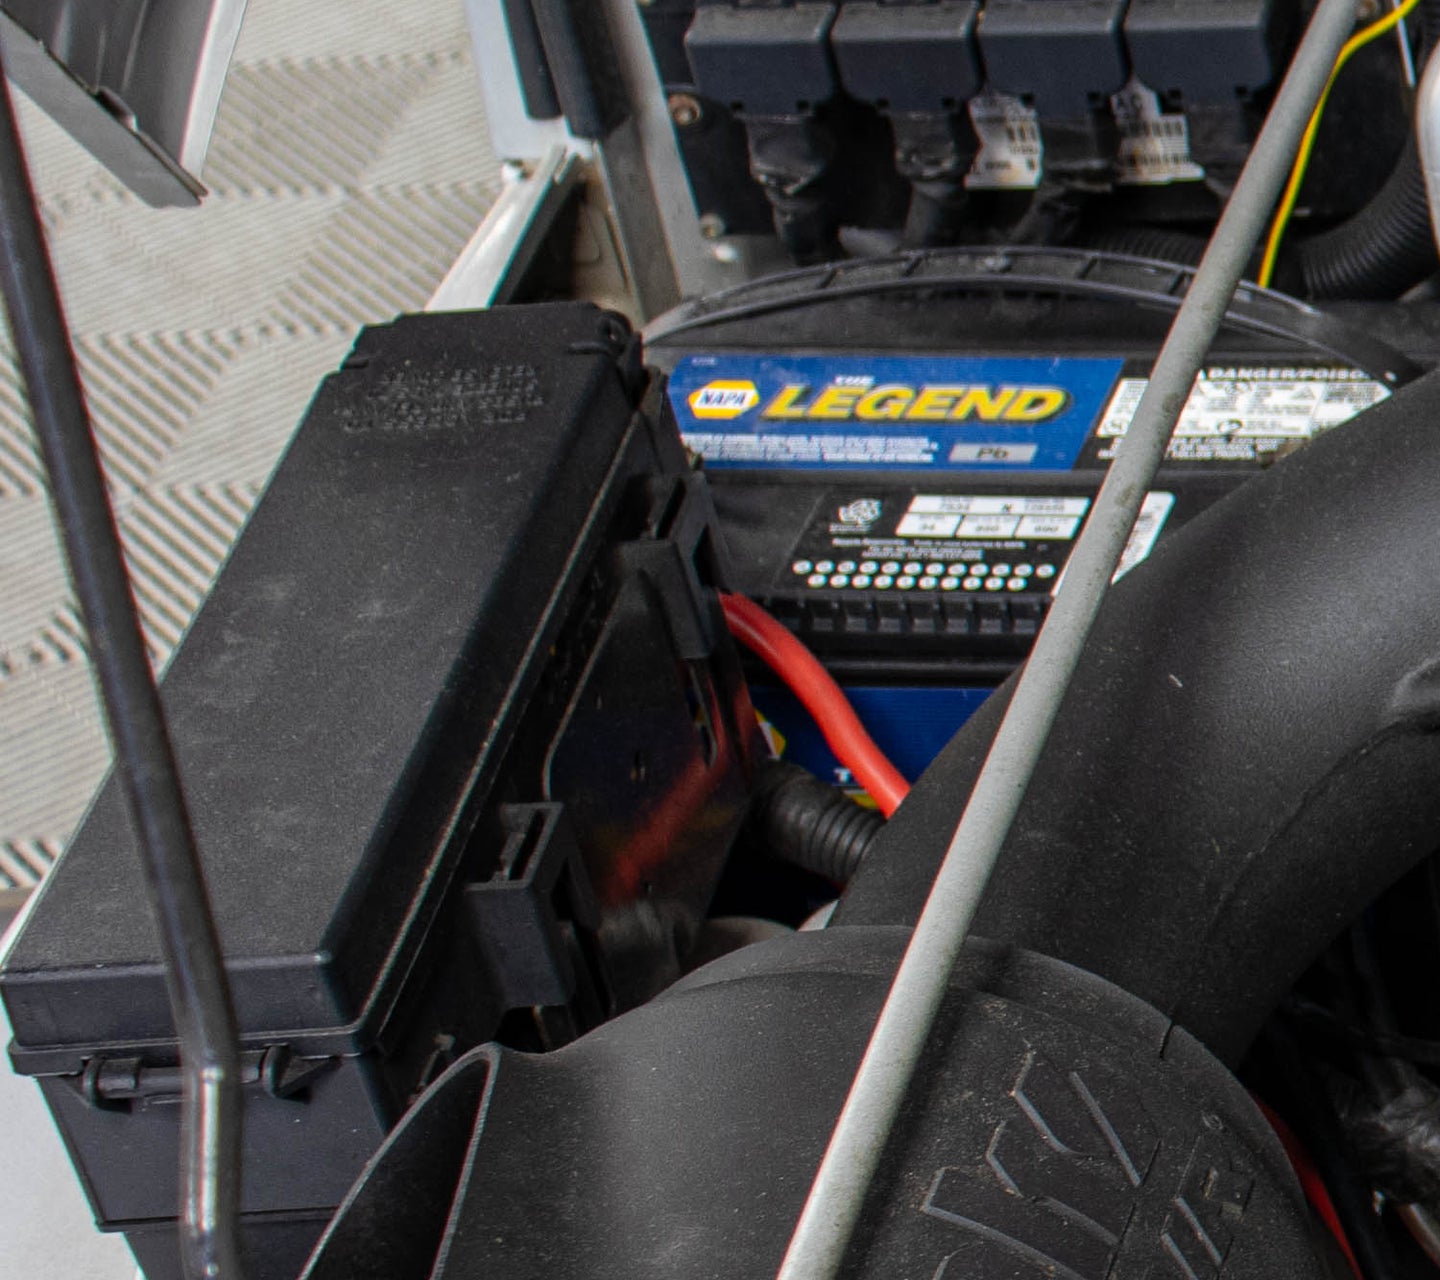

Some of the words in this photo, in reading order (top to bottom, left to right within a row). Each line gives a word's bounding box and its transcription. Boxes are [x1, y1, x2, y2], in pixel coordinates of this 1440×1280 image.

[1208, 367, 1372, 380] DANGER/POISO
[700, 390, 747, 406] NAPA
[762, 383, 1074, 421] LEGEND
